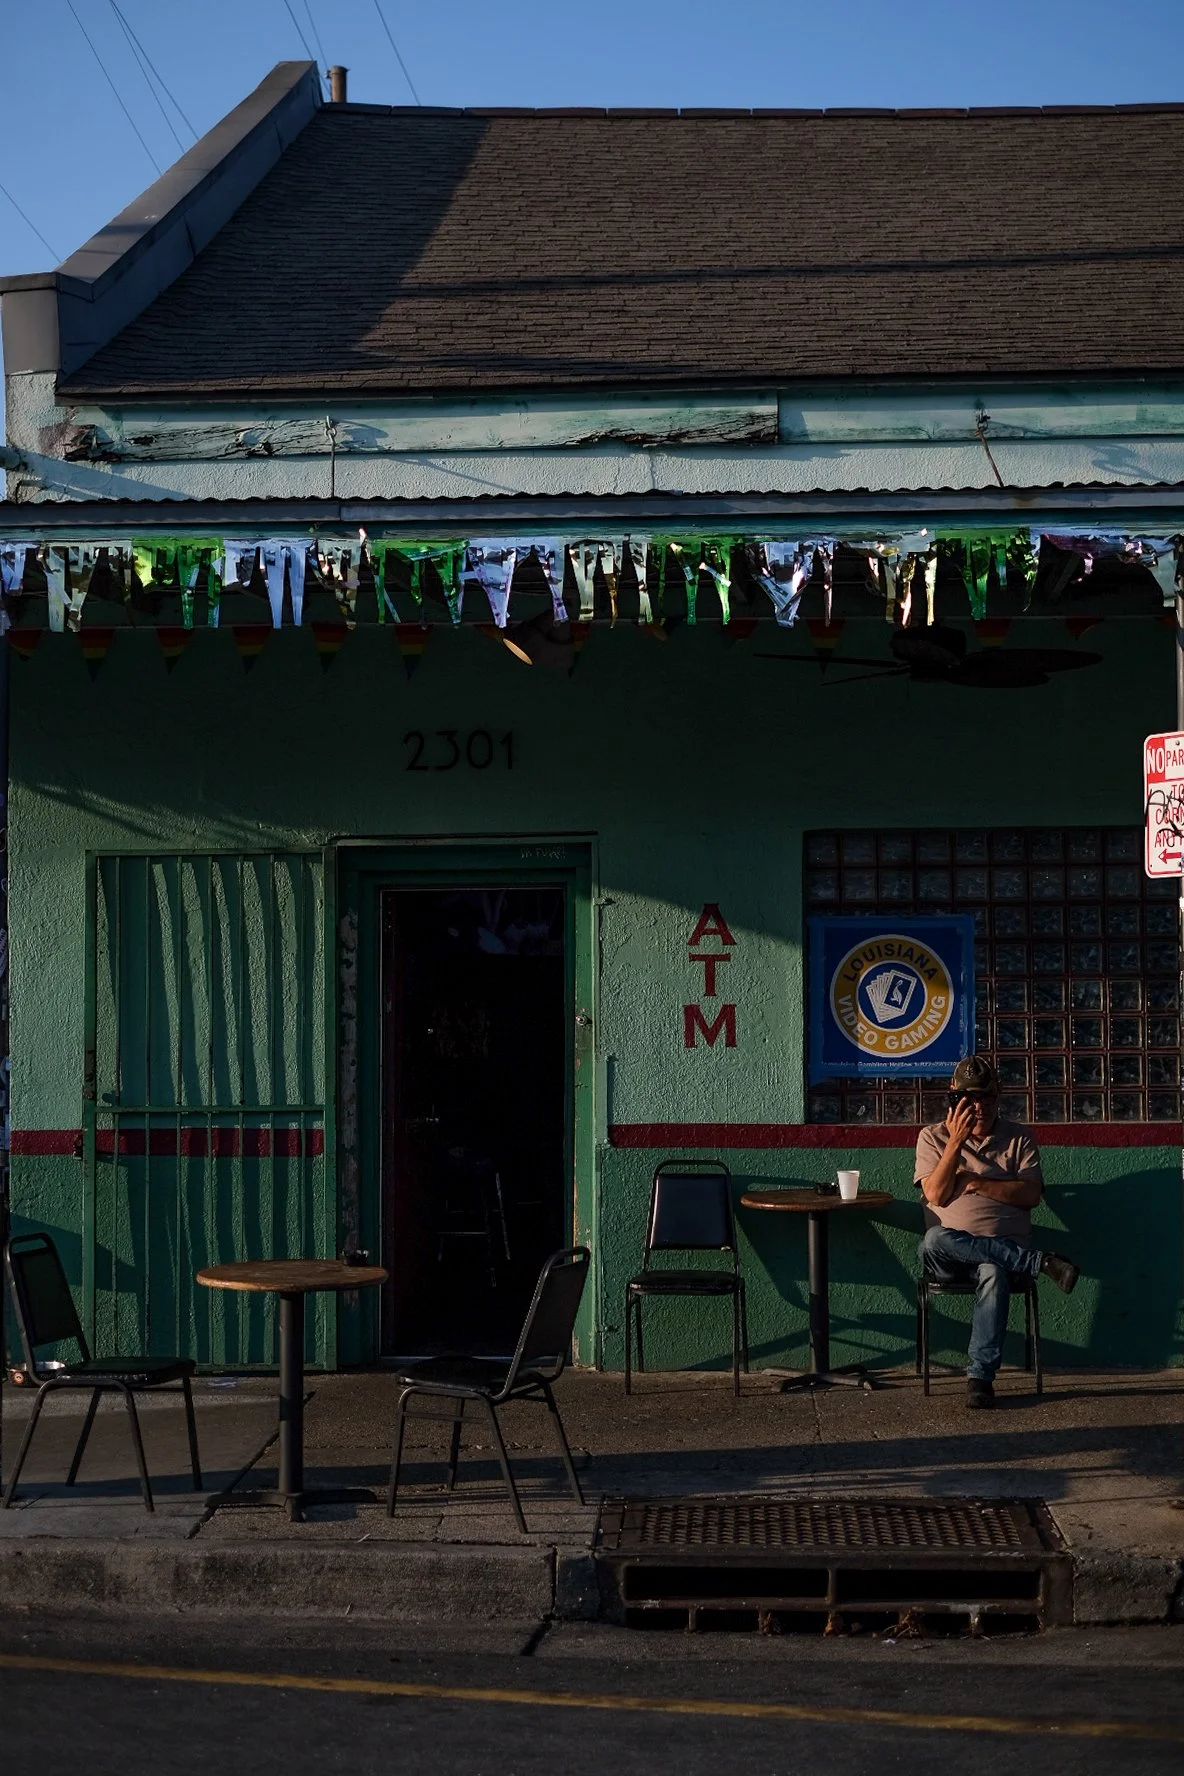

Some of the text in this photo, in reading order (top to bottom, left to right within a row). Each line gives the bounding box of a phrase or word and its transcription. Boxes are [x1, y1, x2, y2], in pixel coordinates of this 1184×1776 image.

[403, 730, 513, 770] 2301
[1147, 747, 1165, 774] NO
[682, 903, 737, 1048] ATM
[843, 943, 938, 982] LOUISIANA
[838, 994, 946, 1050] VIDEO GAMING
